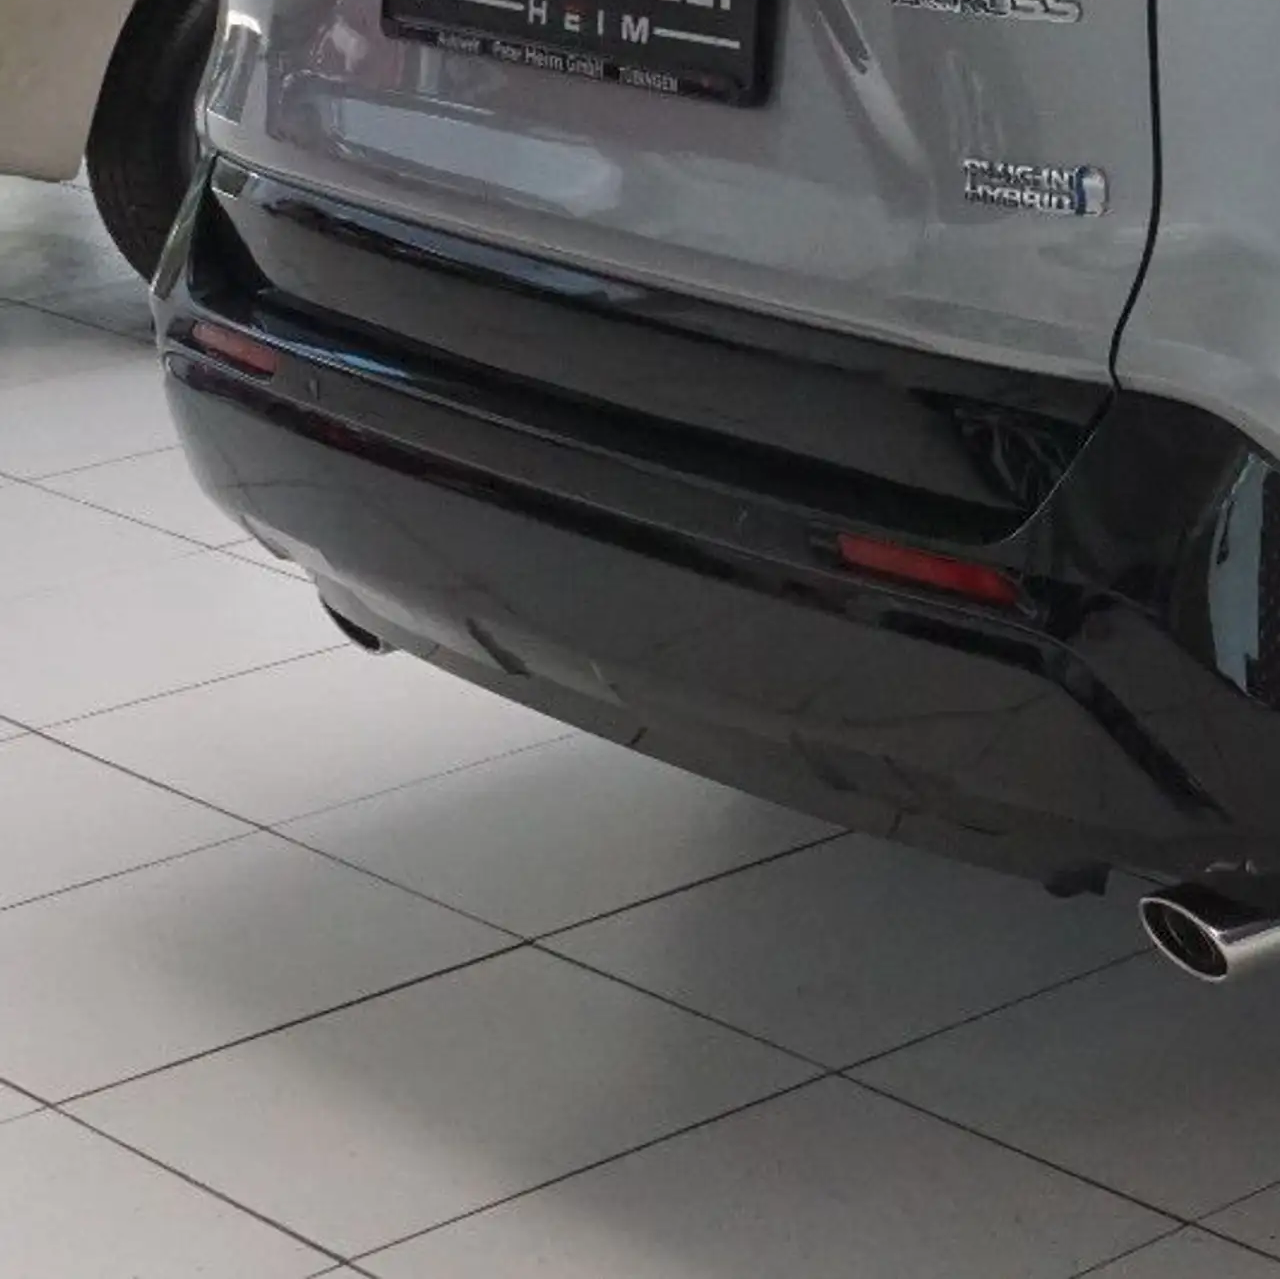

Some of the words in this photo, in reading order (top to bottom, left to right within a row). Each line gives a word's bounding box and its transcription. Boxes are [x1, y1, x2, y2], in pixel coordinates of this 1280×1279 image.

[525, 45, 565, 71] Heim
[567, 54, 604, 80] GmbH
[964, 185, 1075, 213] HYBRID
